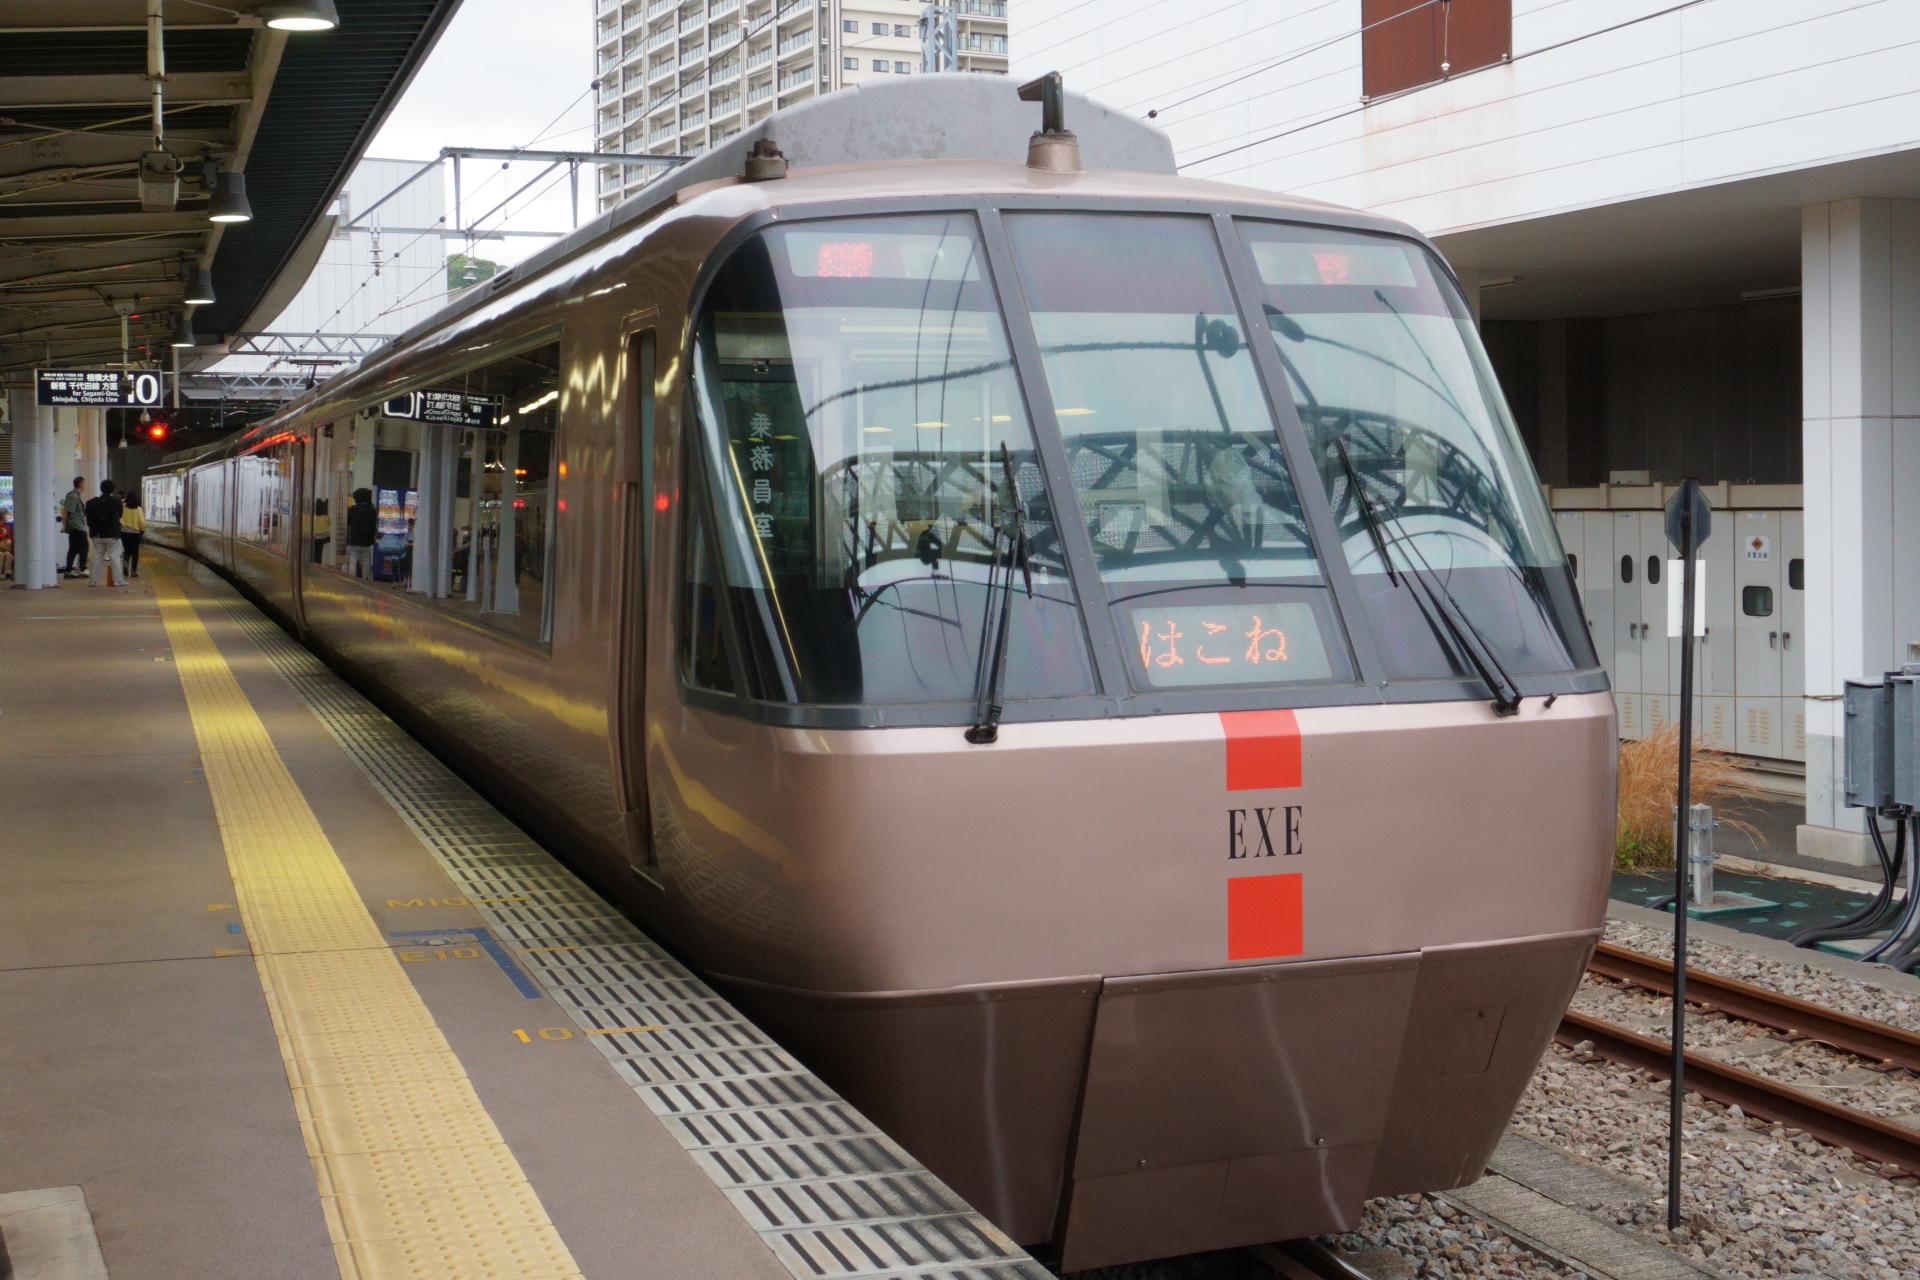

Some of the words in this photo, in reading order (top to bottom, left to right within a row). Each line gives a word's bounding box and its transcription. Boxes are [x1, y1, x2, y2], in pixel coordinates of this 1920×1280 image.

[86, 373, 118, 382] 相模大野
[50, 381, 67, 391] 新宿
[68, 381, 100, 391] 千代田線
[102, 381, 118, 391] 方面
[51, 396, 80, 404] Shinjuku,
[80, 396, 105, 404] Chiyoda
[1140, 615, 1288, 668] はこね
[1227, 805, 1303, 860] EXE
[385, 898, 469, 908] M10
[399, 948, 481, 962] E10
[511, 1027, 574, 1043] 10
